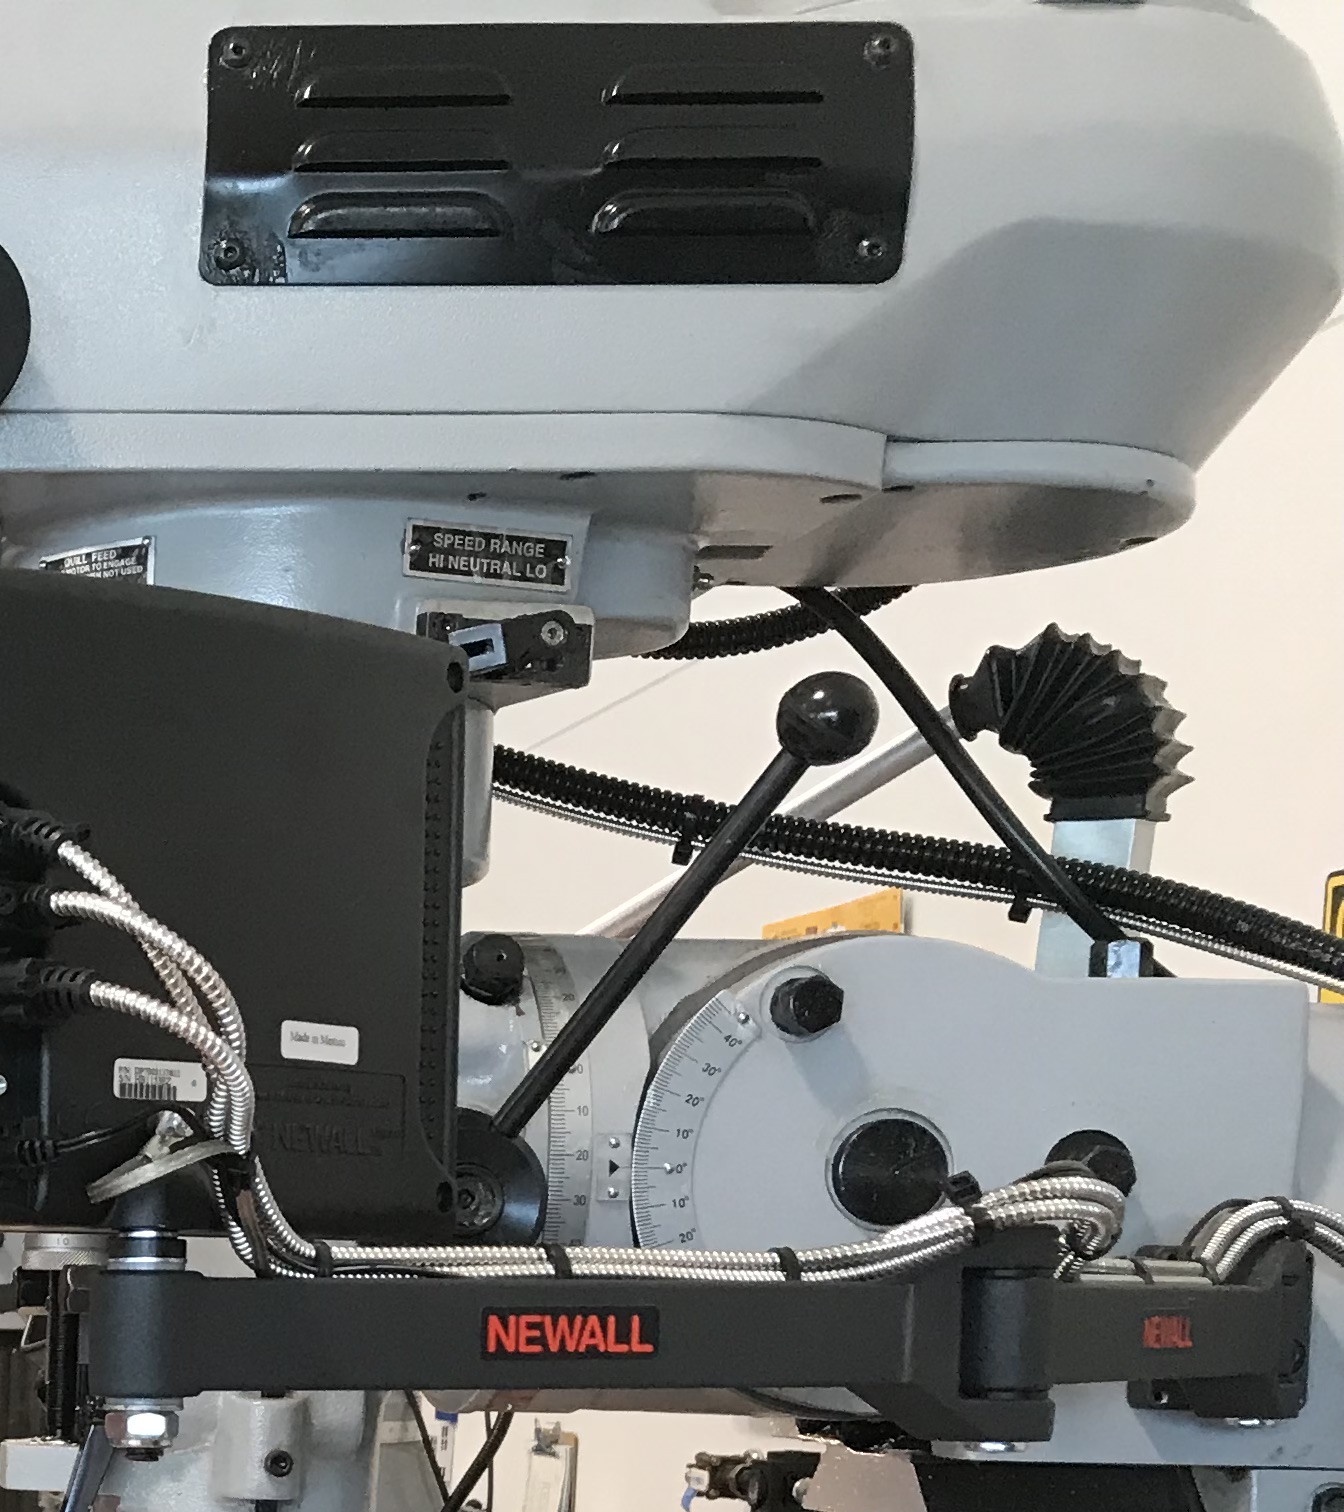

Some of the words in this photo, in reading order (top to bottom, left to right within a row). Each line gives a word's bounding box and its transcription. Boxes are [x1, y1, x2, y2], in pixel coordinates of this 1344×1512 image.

[433, 532, 486, 552] SPEED
[490, 539, 546, 558] RANGE
[92, 549, 117, 562] FEED
[92, 563, 102, 571] TO
[103, 556, 138, 569] ENGAGE
[428, 553, 445, 568] HI
[448, 555, 522, 577] NEUTRAL
[526, 563, 548, 579] LO
[103, 568, 119, 578] NOT
[120, 565, 144, 575] USED
[577, 1105, 589, 1116] 10
[575, 1150, 589, 1161] 20
[573, 1195, 587, 1206] 30
[486, 1314, 654, 1353] NEWALL
[1143, 1315, 1193, 1348] NEWALL
